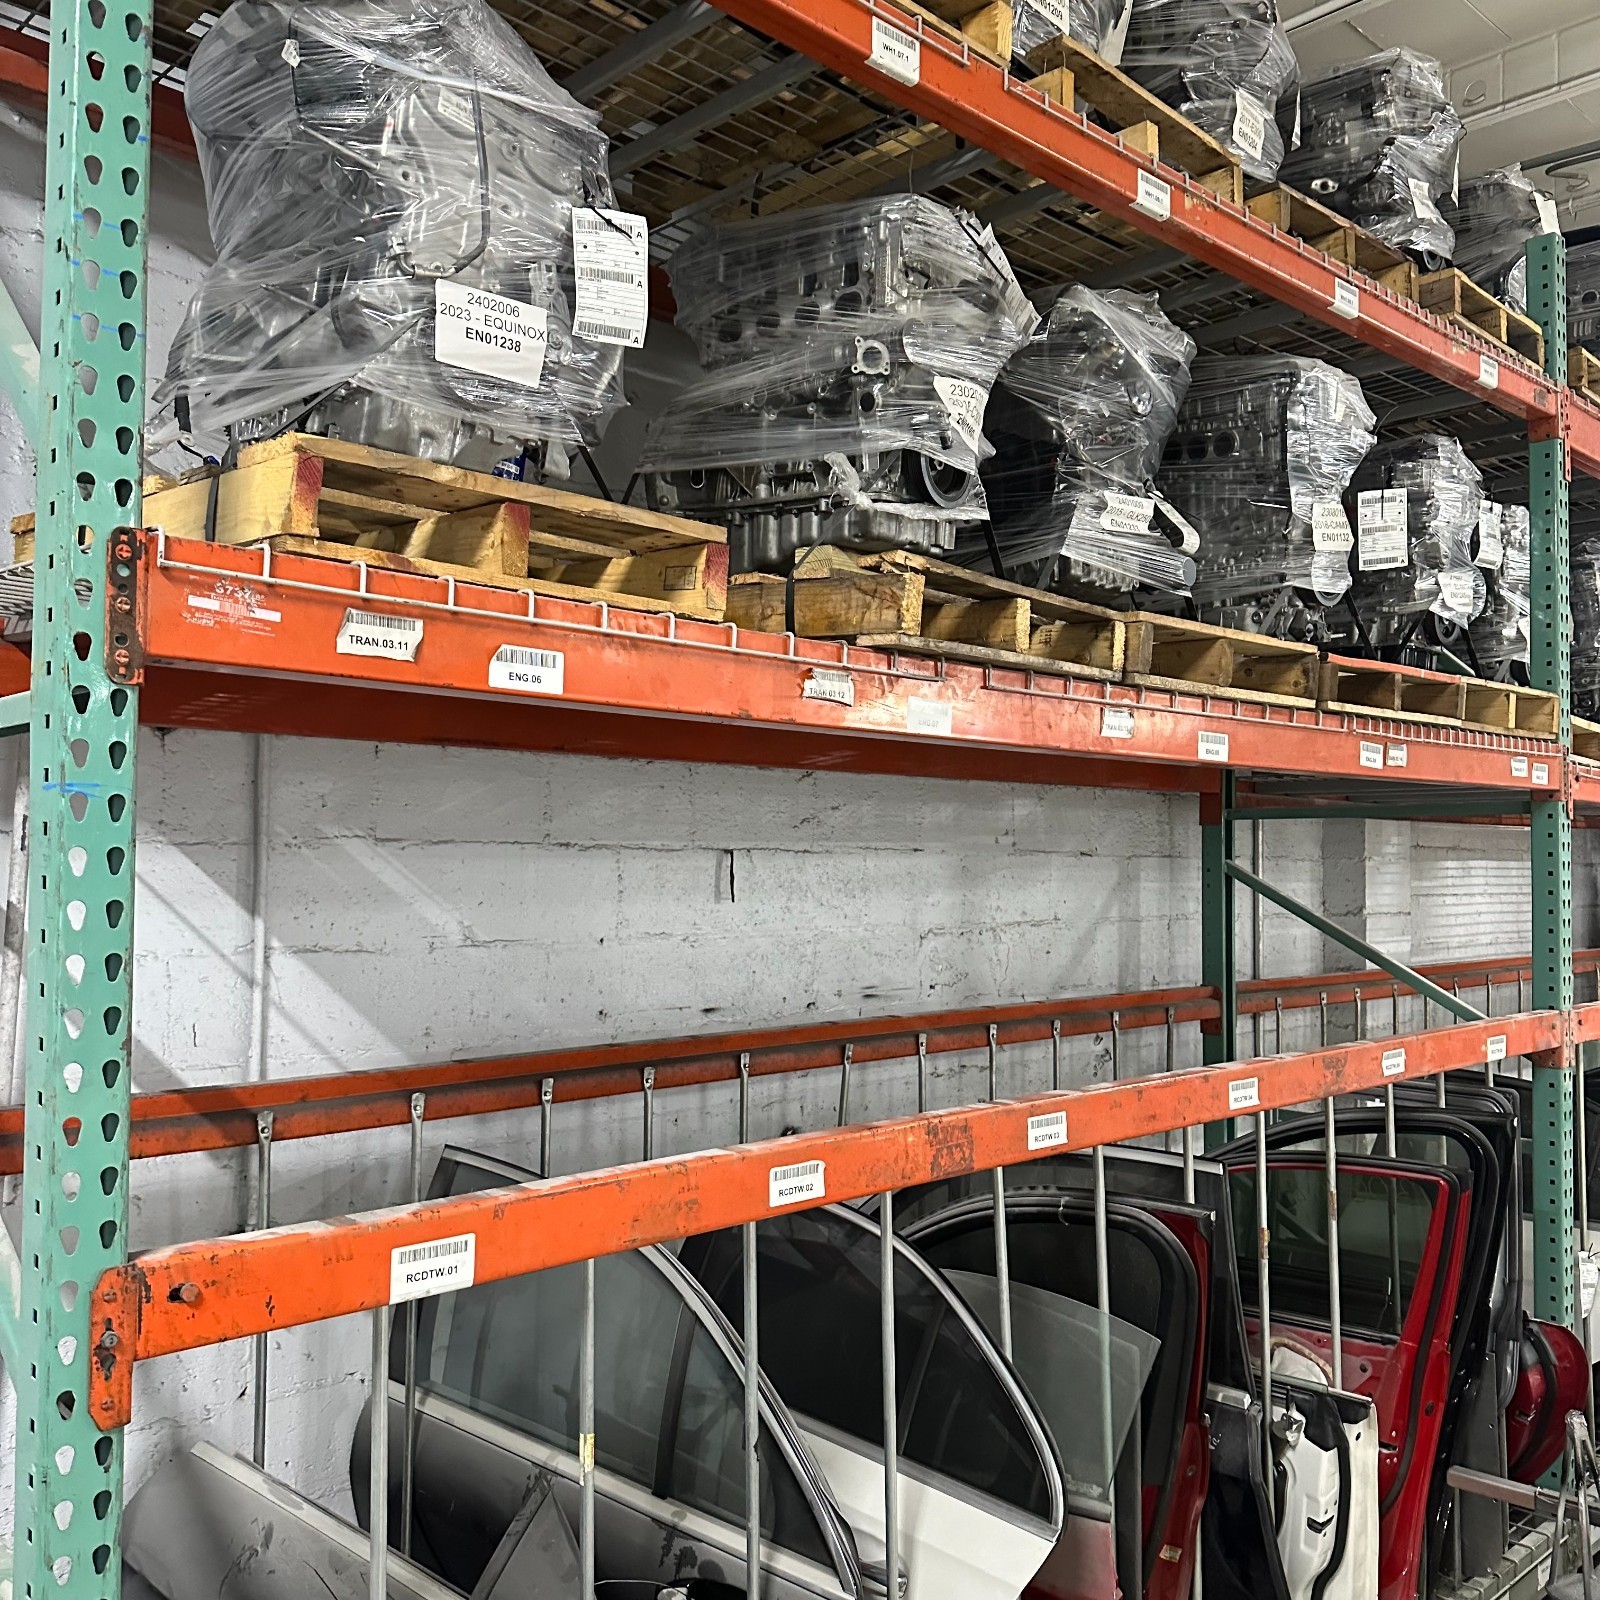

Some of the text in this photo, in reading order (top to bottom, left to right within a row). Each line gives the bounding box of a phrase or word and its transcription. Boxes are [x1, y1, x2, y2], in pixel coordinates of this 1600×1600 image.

[883, 42, 909, 63] WH1.07.1
[636, 231, 643, 239] A
[636, 280, 643, 288] A
[467, 292, 520, 318] 2402006
[440, 302, 472, 322] 2023
[484, 314, 546, 342] EQUINOX
[465, 327, 522, 353] EN01238
[632, 336, 639, 344] A
[1321, 532, 1350, 542] EN01132
[349, 634, 408, 651] TRAN.03.11
[509, 671, 542, 684] ENG.06
[778, 1183, 814, 1198] RCDTW.02
[406, 1264, 458, 1284] RCDTW.01
